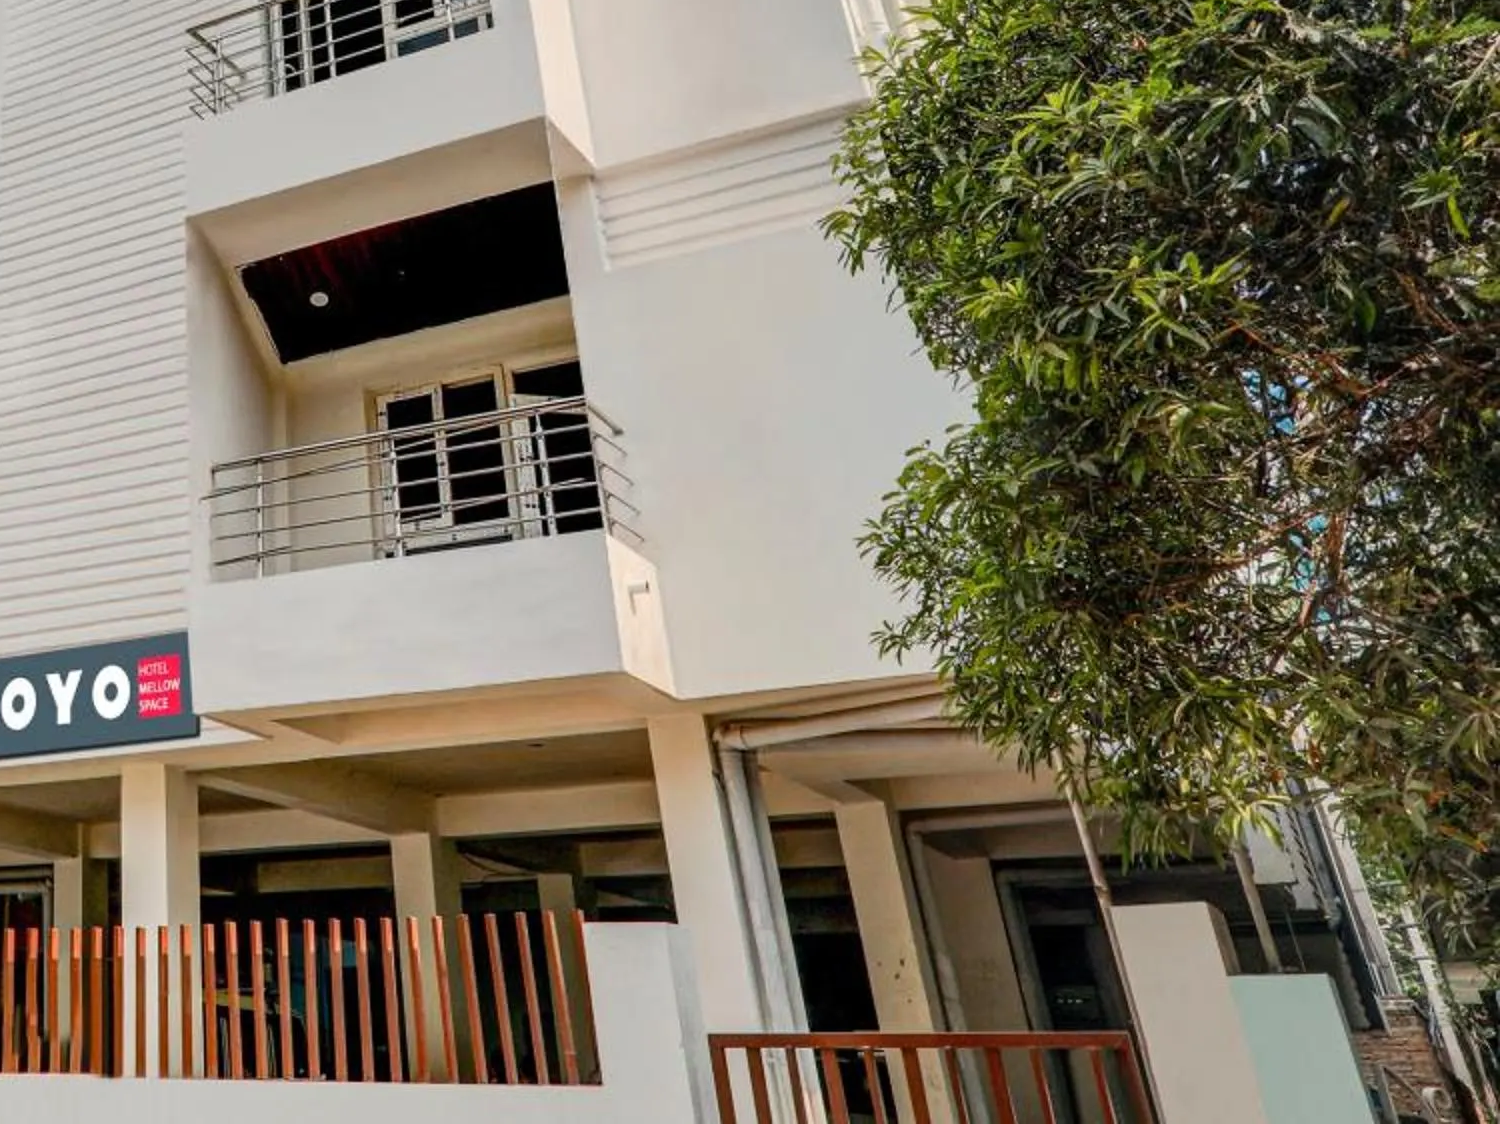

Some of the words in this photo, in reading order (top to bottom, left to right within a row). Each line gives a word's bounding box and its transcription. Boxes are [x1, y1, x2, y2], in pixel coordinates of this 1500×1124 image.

[138, 661, 169, 676] HOTEL
[138, 678, 180, 693] MELLOW
[1, 664, 130, 731] OYO
[138, 697, 169, 713] SPACE
